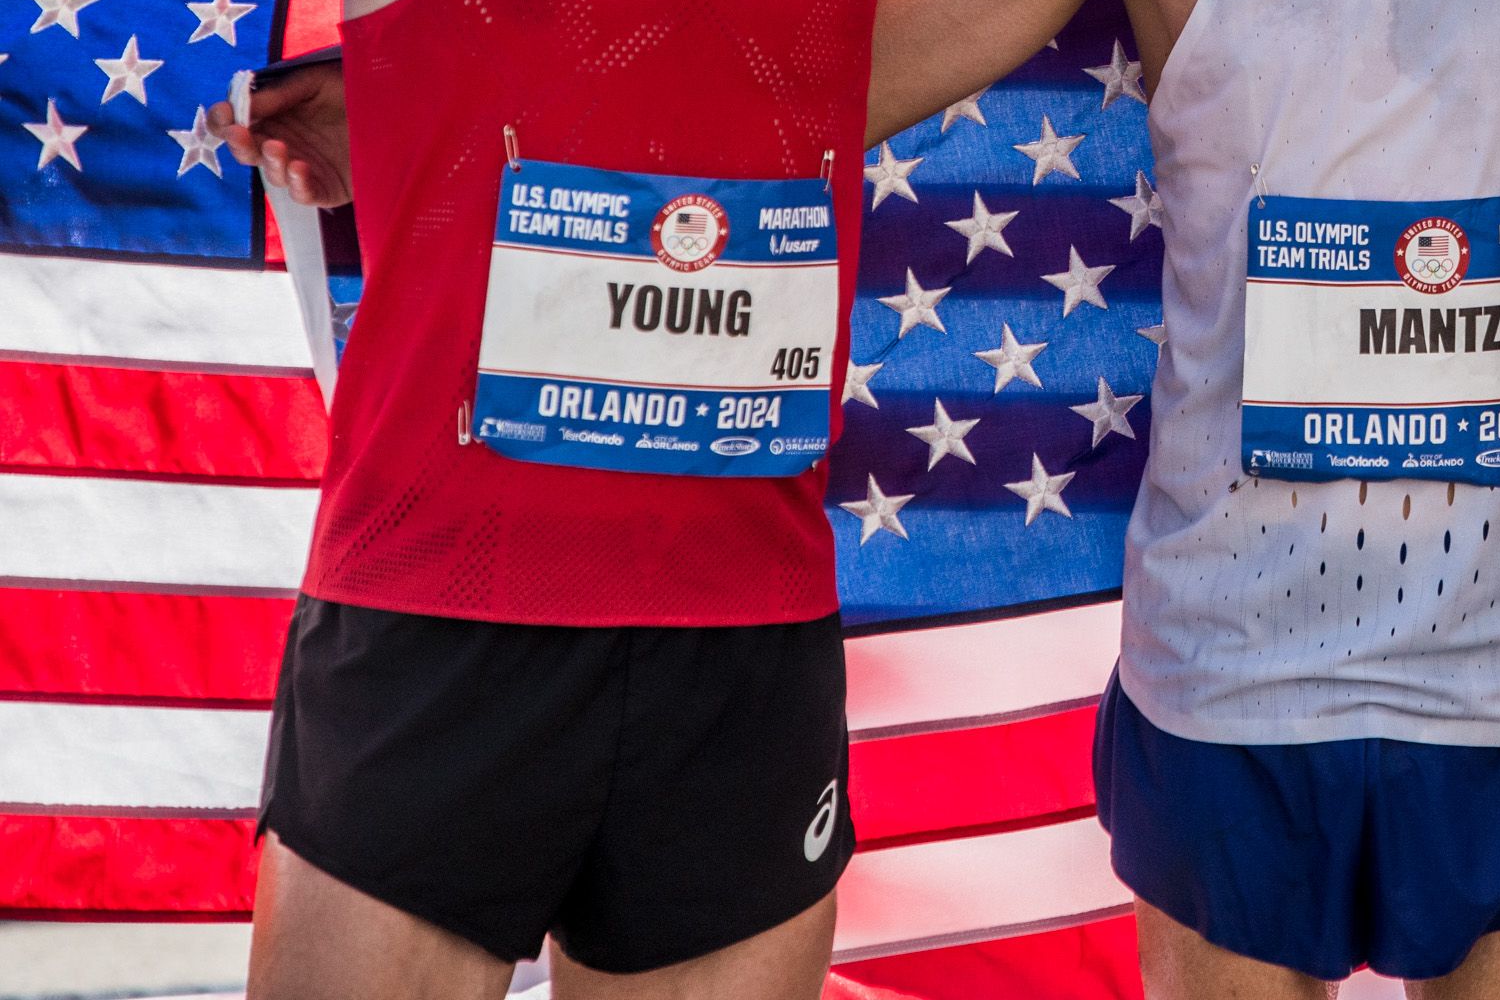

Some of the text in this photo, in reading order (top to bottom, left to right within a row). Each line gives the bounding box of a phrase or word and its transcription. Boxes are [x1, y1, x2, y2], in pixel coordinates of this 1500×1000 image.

[512, 184, 630, 217] U.S. OLYMPIC
[662, 196, 693, 216] UNITED
[509, 210, 629, 244] TEAM TRIALS
[759, 206, 829, 230] MARATHON
[1403, 219, 1463, 240] UNITED STATES
[1259, 220, 1369, 246] U.S. OLYMPIC
[785, 239, 820, 253] USATF
[1257, 246, 1370, 272] TEAM TRIALS
[1403, 272, 1462, 293] OLYMPIC TEAM
[607, 282, 752, 337] YOUNG
[770, 347, 821, 381] 405
[538, 384, 782, 430] ORLANDO 2024
[1304, 412, 1447, 446] ORLANDO
[653, 441, 700, 452] ORLANDO
[785, 443, 826, 451] ORLANDO
[1419, 458, 1465, 468] ORLANDO
